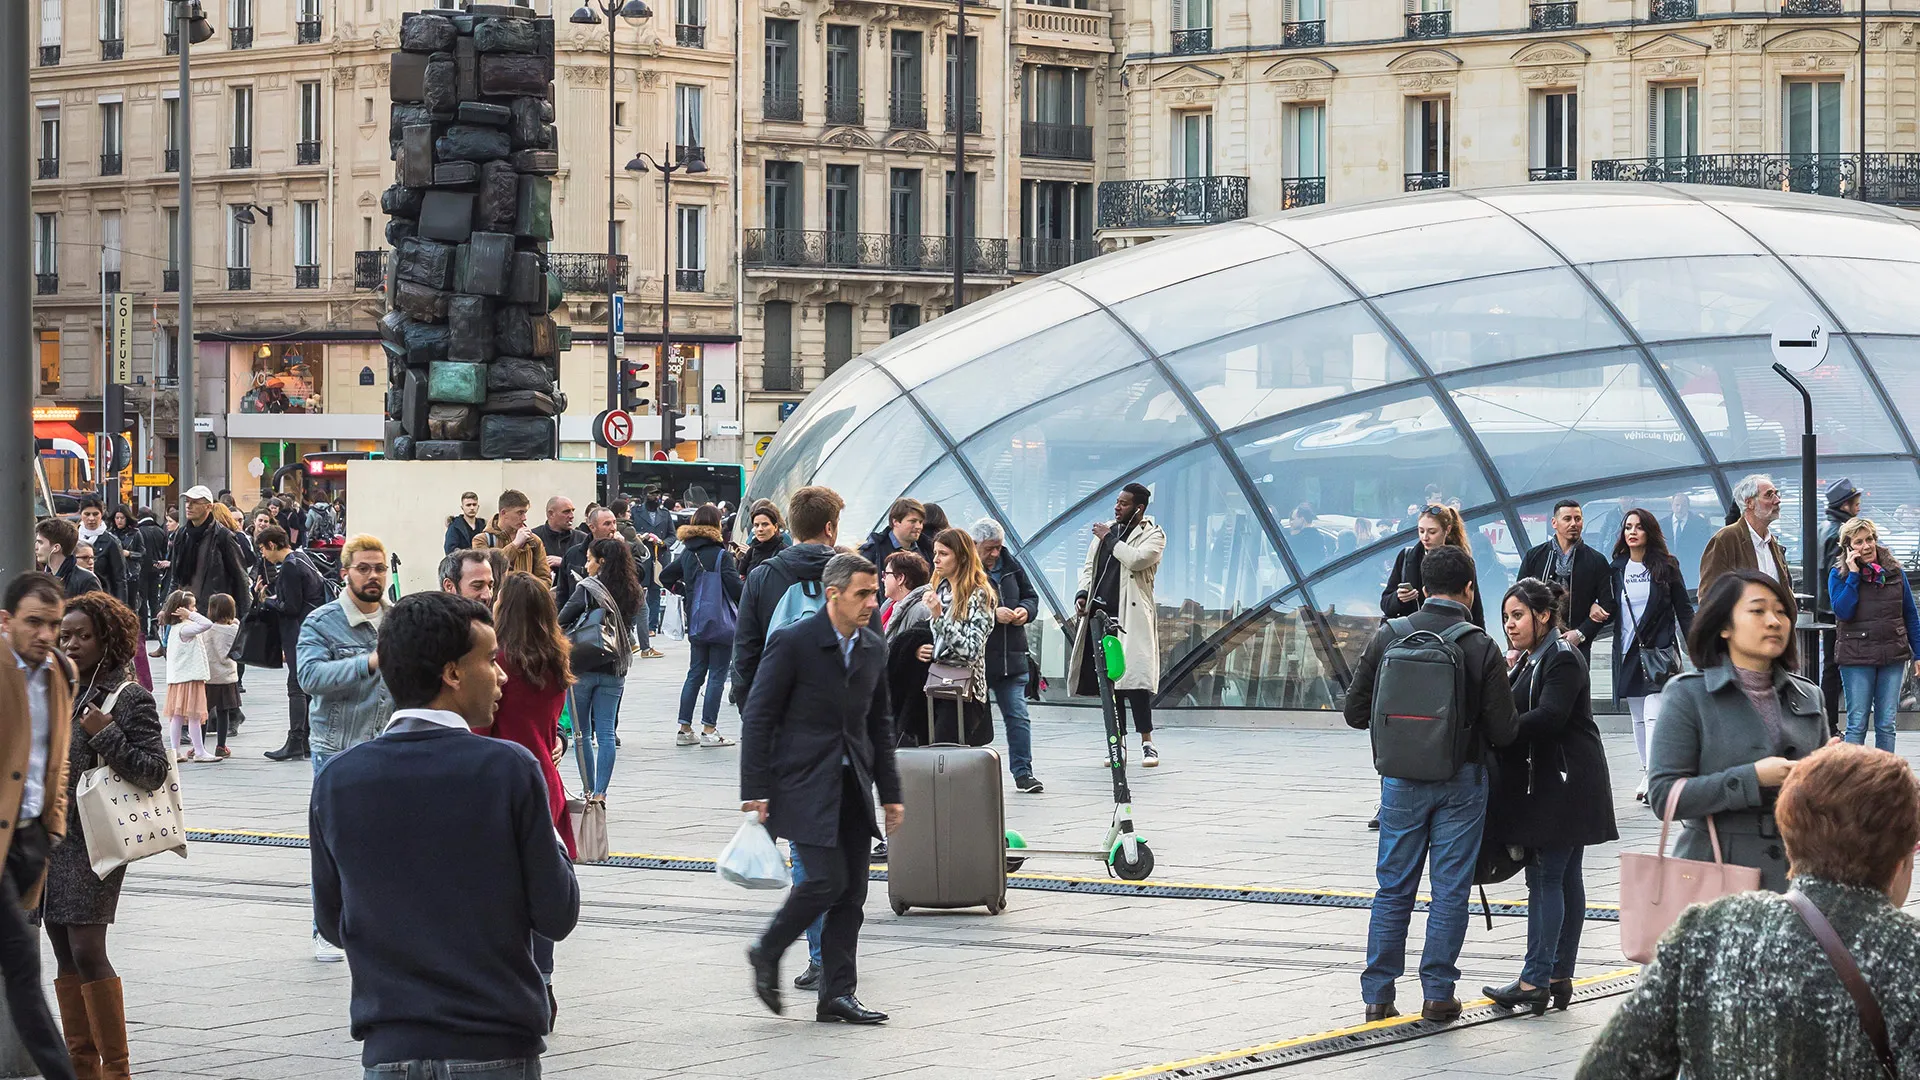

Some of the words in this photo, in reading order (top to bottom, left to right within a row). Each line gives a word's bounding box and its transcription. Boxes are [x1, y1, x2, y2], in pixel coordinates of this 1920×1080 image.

[617, 302, 622, 326] P
[119, 297, 128, 380] COIFFURE
[1624, 430, 1661, 440] véhicule
